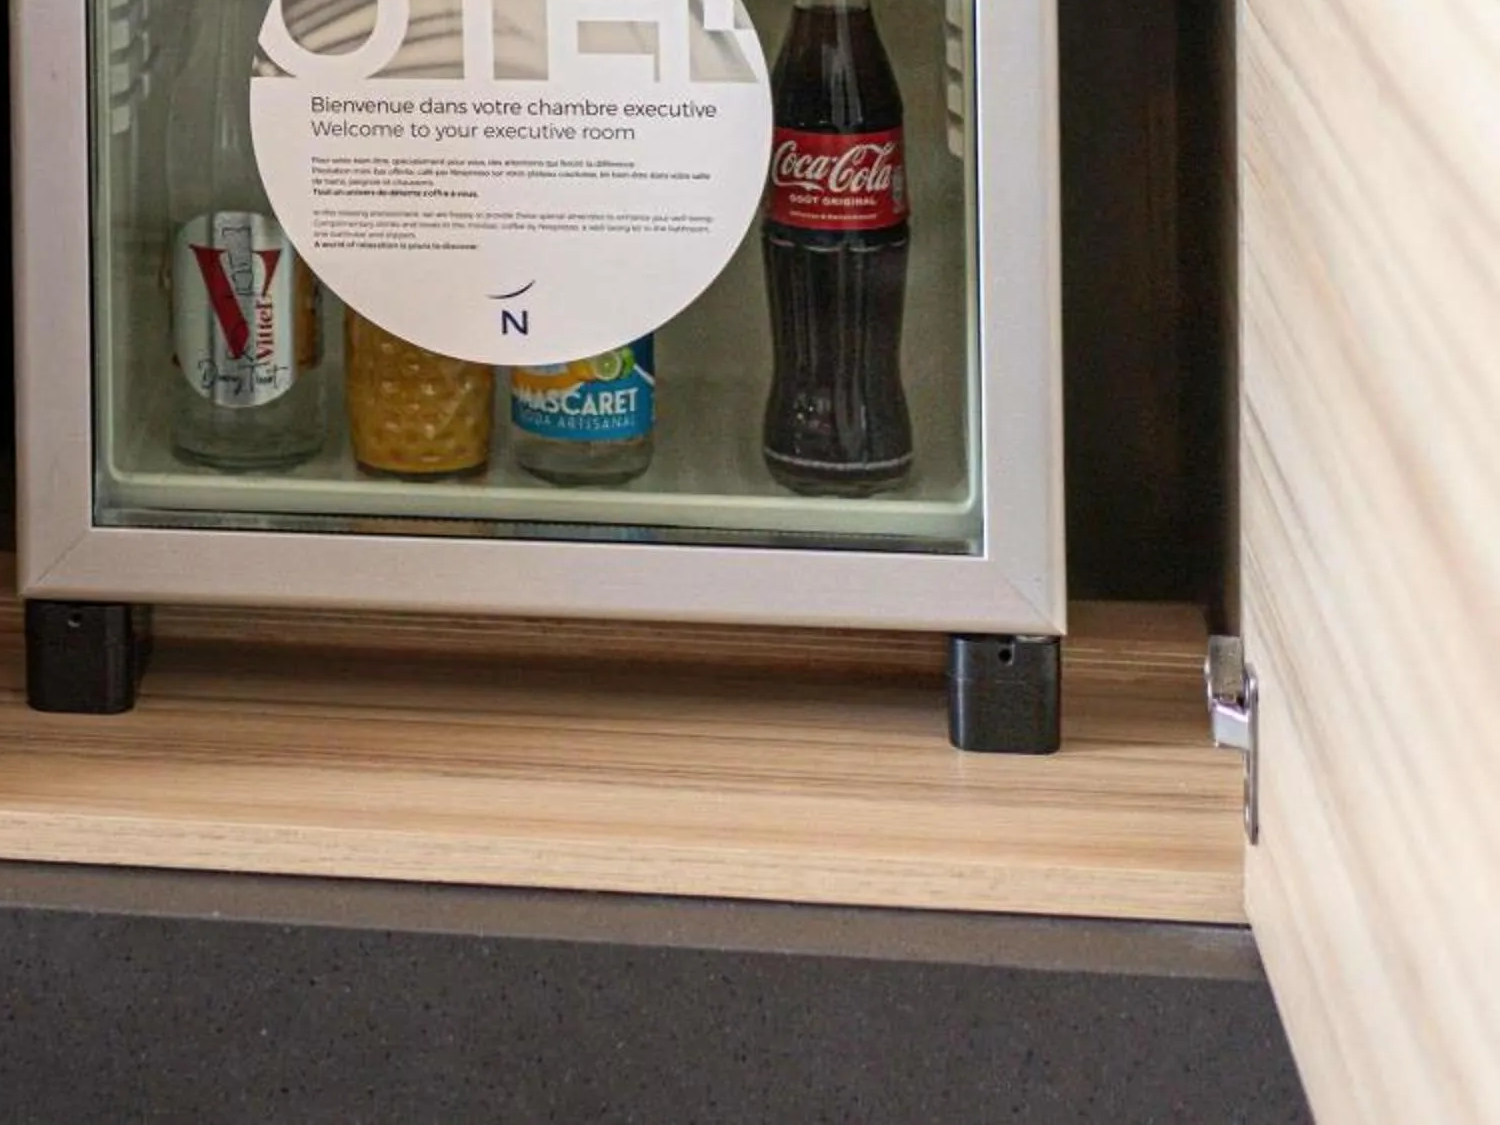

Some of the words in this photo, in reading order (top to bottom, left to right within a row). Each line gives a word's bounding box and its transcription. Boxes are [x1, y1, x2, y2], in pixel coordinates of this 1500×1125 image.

[311, 96, 414, 114] Bienvenue
[419, 97, 468, 114] dans
[473, 99, 522, 115] votre
[527, 98, 618, 116] chambre
[623, 101, 717, 118] executive
[311, 120, 404, 137] Welcome
[411, 123, 431, 138] to
[435, 125, 478, 141] your
[483, 123, 576, 140] executive
[582, 127, 635, 140] room
[772, 140, 895, 193] Coca-Cola
[256, 298, 274, 360] Vittel
[502, 310, 528, 335] N
